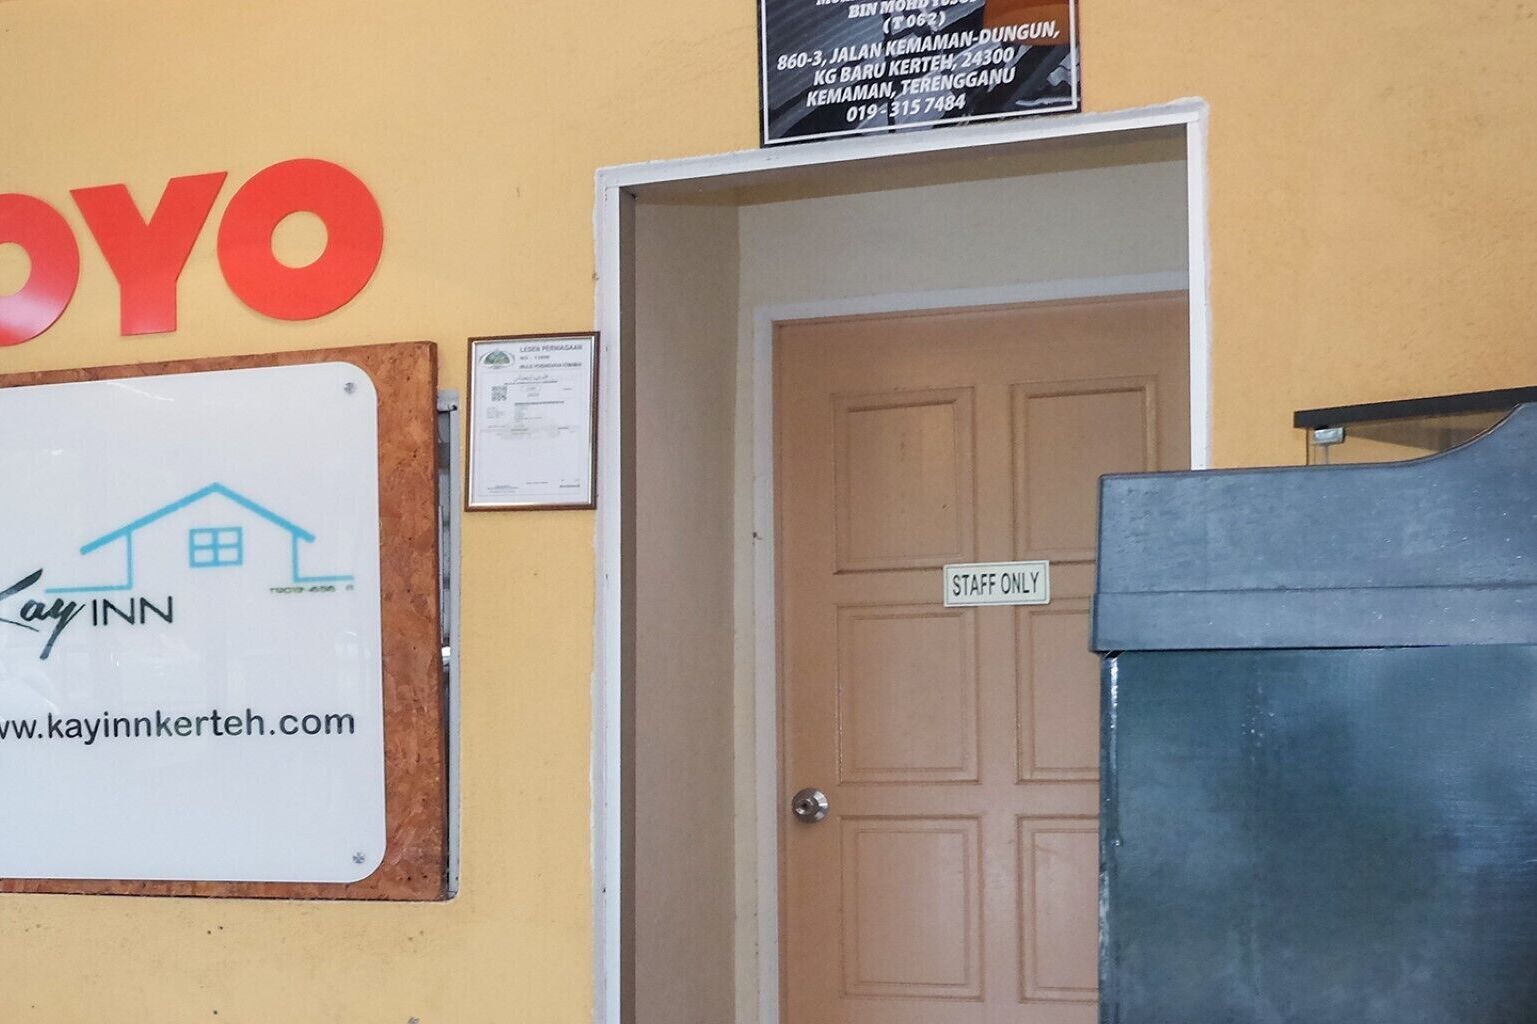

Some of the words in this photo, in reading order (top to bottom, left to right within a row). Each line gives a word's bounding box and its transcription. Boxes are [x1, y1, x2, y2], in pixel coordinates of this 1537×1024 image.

[848, 2, 878, 19] BIN
[777, 50, 826, 71] 860-3,
[829, 42, 883, 64] JALAN
[885, 20, 1060, 57] KEMAMAN-DUNGUN,
[813, 68, 837, 86] KG
[840, 62, 886, 83] BARU
[888, 55, 957, 76] KERTEH,
[961, 47, 1015, 67] 24300
[806, 81, 896, 107] KEMAMAN,
[901, 67, 1016, 95] TERENGGANU
[923, 93, 966, 114] 7484
[952, 573, 996, 597] STAFF
[1000, 571, 1040, 595] ONLY
[91, 595, 174, 627] INN
